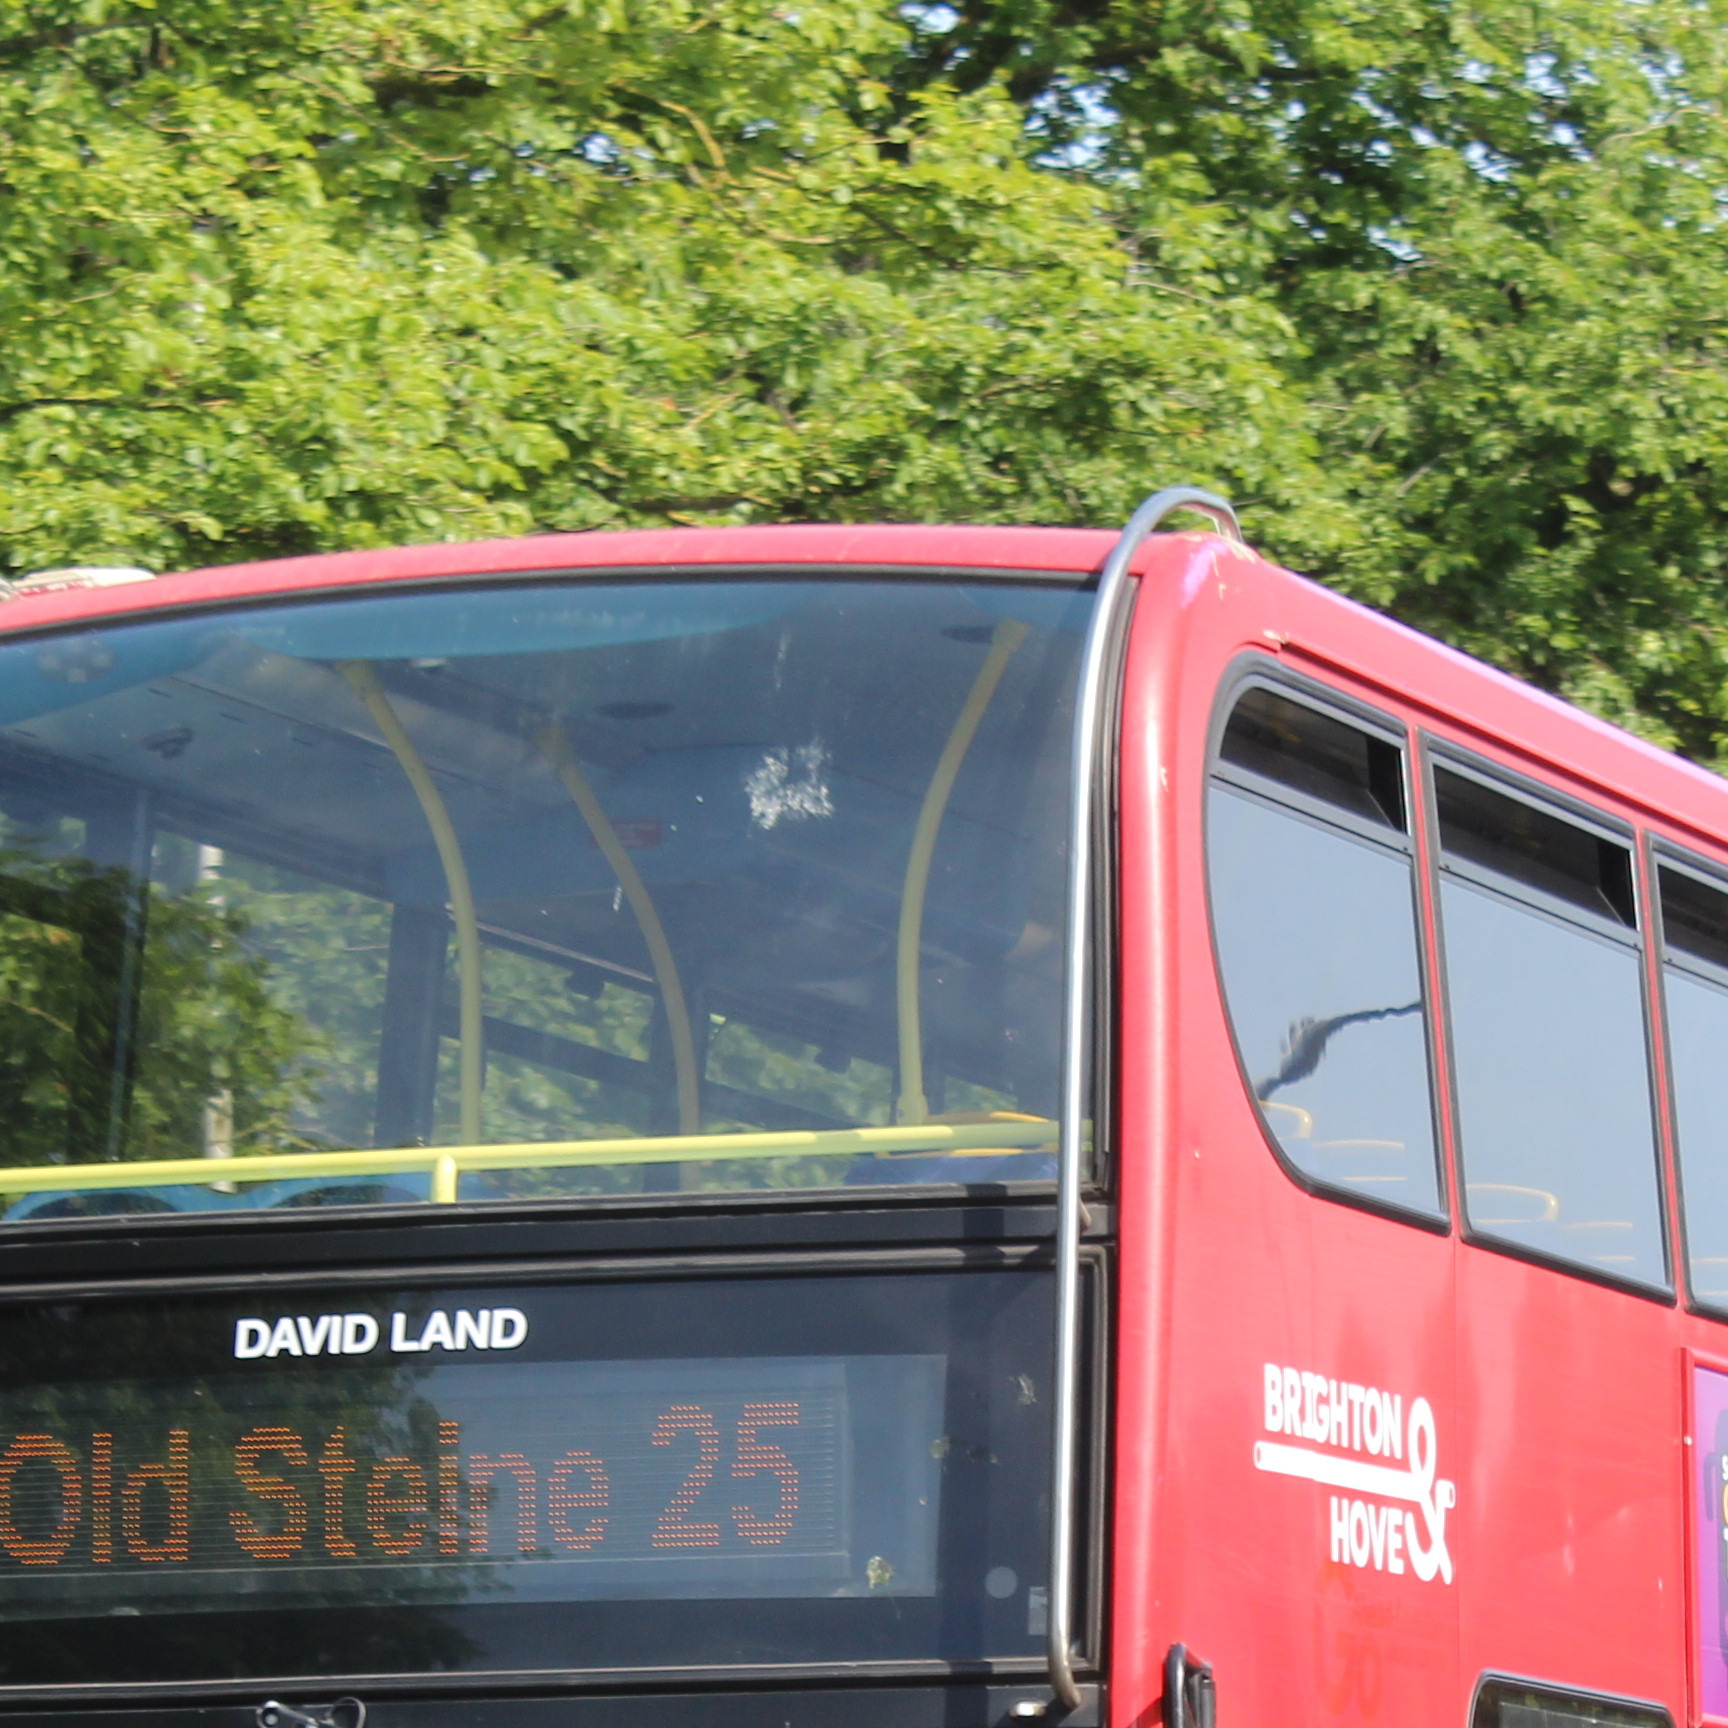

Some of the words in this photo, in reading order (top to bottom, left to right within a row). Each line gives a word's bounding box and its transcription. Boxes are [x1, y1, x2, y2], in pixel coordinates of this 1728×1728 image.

[235, 1314, 381, 1360] DAVID
[391, 1308, 530, 1354] LAND
[1264, 1363, 1402, 1459] BRIGHTON
[228, 1419, 611, 1560] Steine
[651, 1402, 801, 1549] 25
[1330, 1496, 1404, 1576] HOVE
